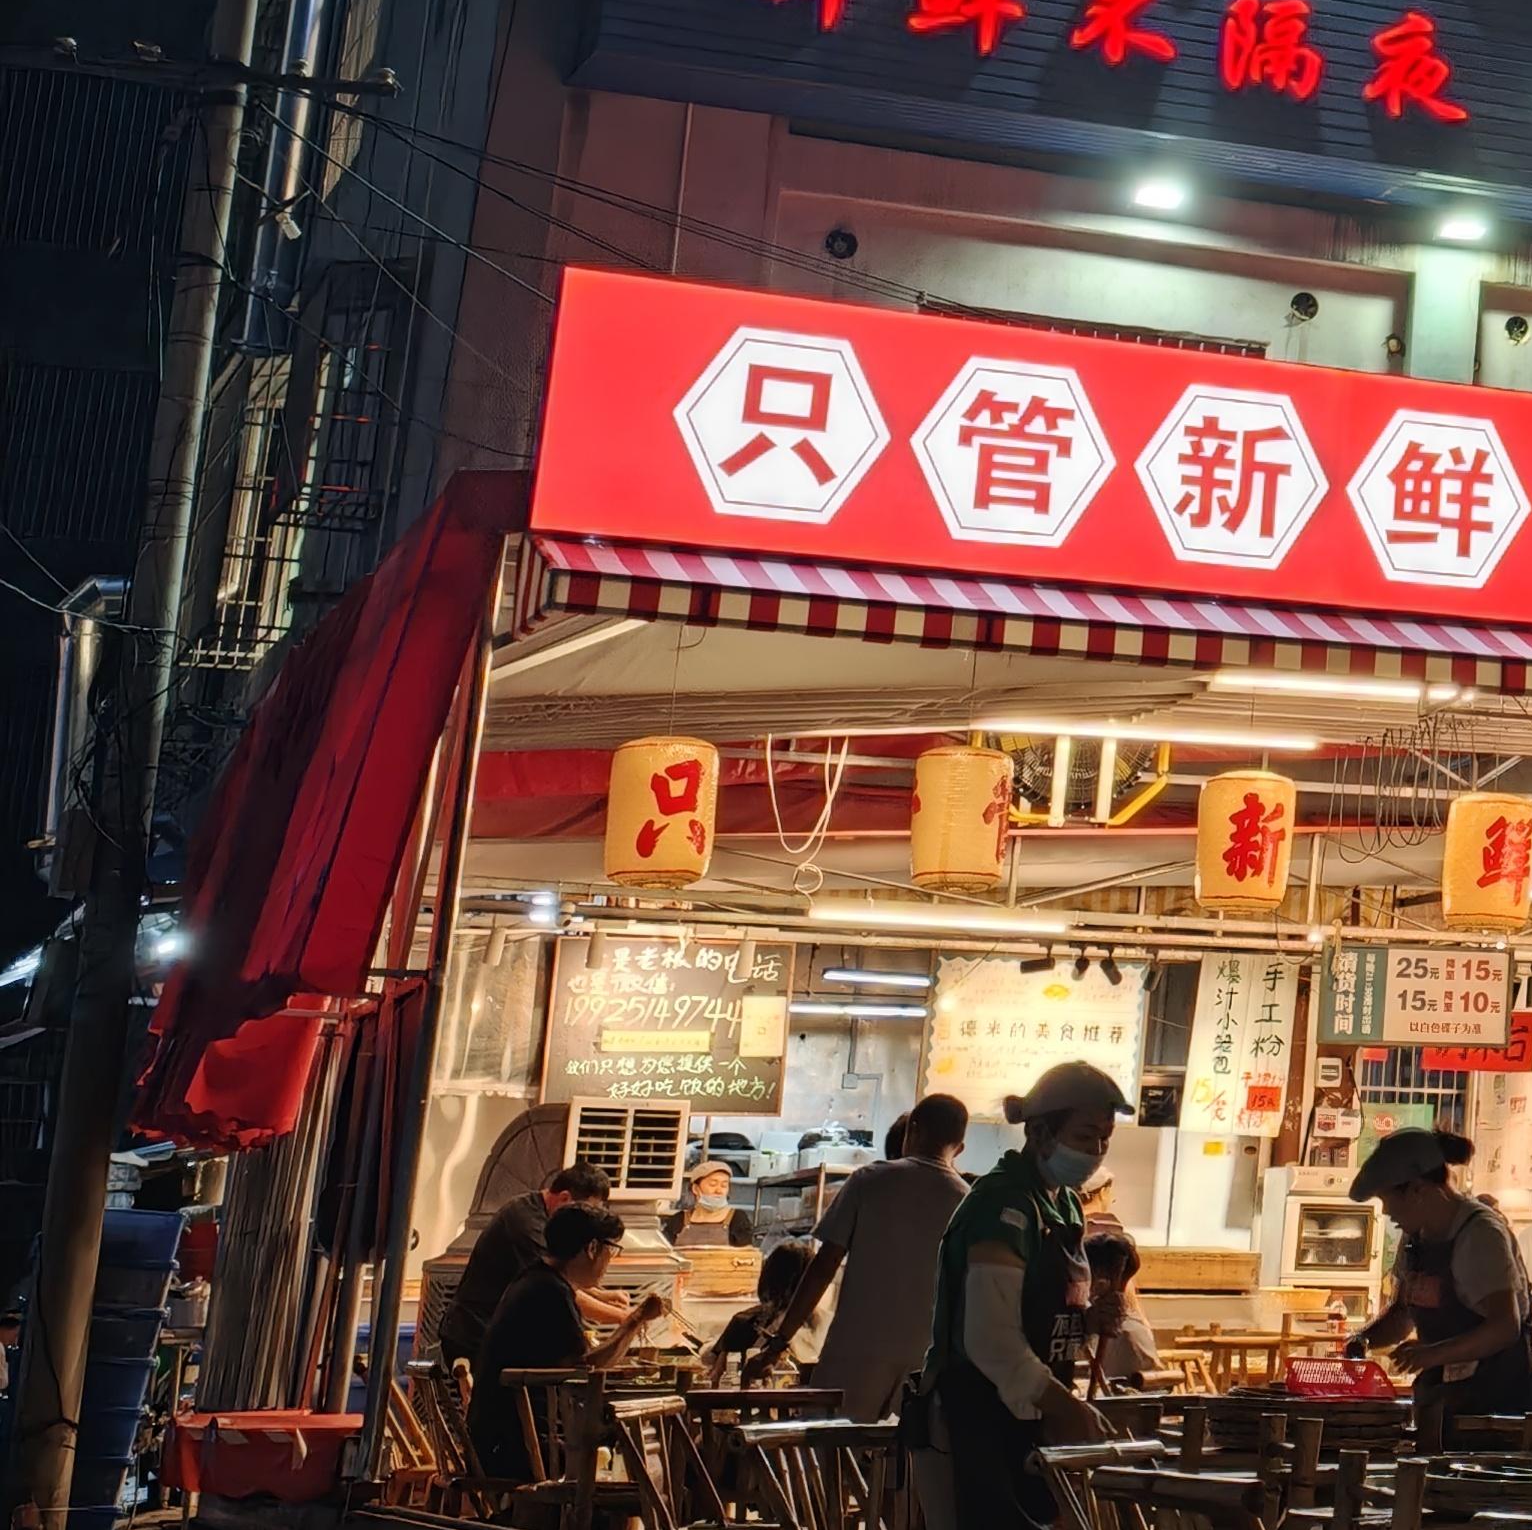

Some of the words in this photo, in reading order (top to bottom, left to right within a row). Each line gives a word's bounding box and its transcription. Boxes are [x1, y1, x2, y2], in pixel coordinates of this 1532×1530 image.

[717, 363, 1496, 559] 只管新鲜
[636, 759, 707, 859] 只
[1221, 792, 1287, 887] 新
[1250, 961, 1286, 1059] 手工粉
[1396, 957, 1440, 980] 25元
[1461, 958, 1503, 982] 15元
[1397, 989, 1438, 1012] 15元
[1459, 991, 1501, 1014] 10元
